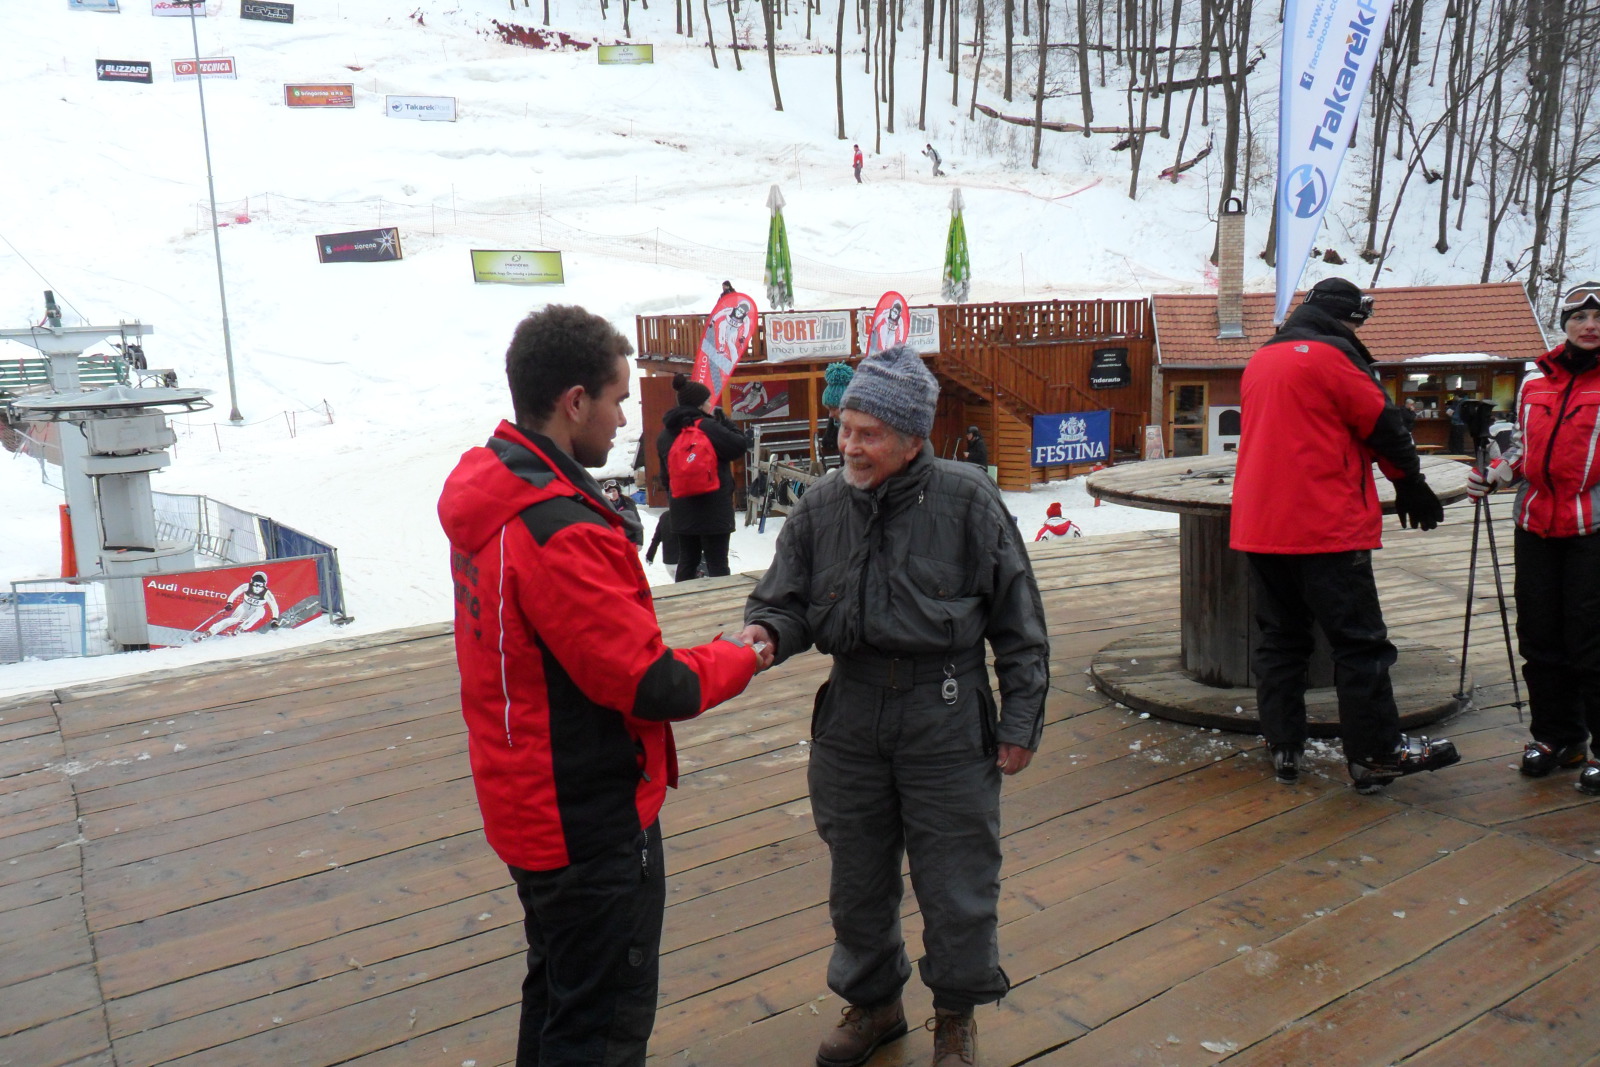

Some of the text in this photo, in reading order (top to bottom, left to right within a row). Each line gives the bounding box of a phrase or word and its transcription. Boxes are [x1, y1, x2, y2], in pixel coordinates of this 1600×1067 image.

[772, 318, 845, 341] PORT.hu
[772, 345, 795, 354] mozi
[799, 345, 809, 354] tv
[1035, 441, 1106, 463] FESTINA
[147, 580, 178, 592] Audi
[182, 586, 228, 600] quattro
